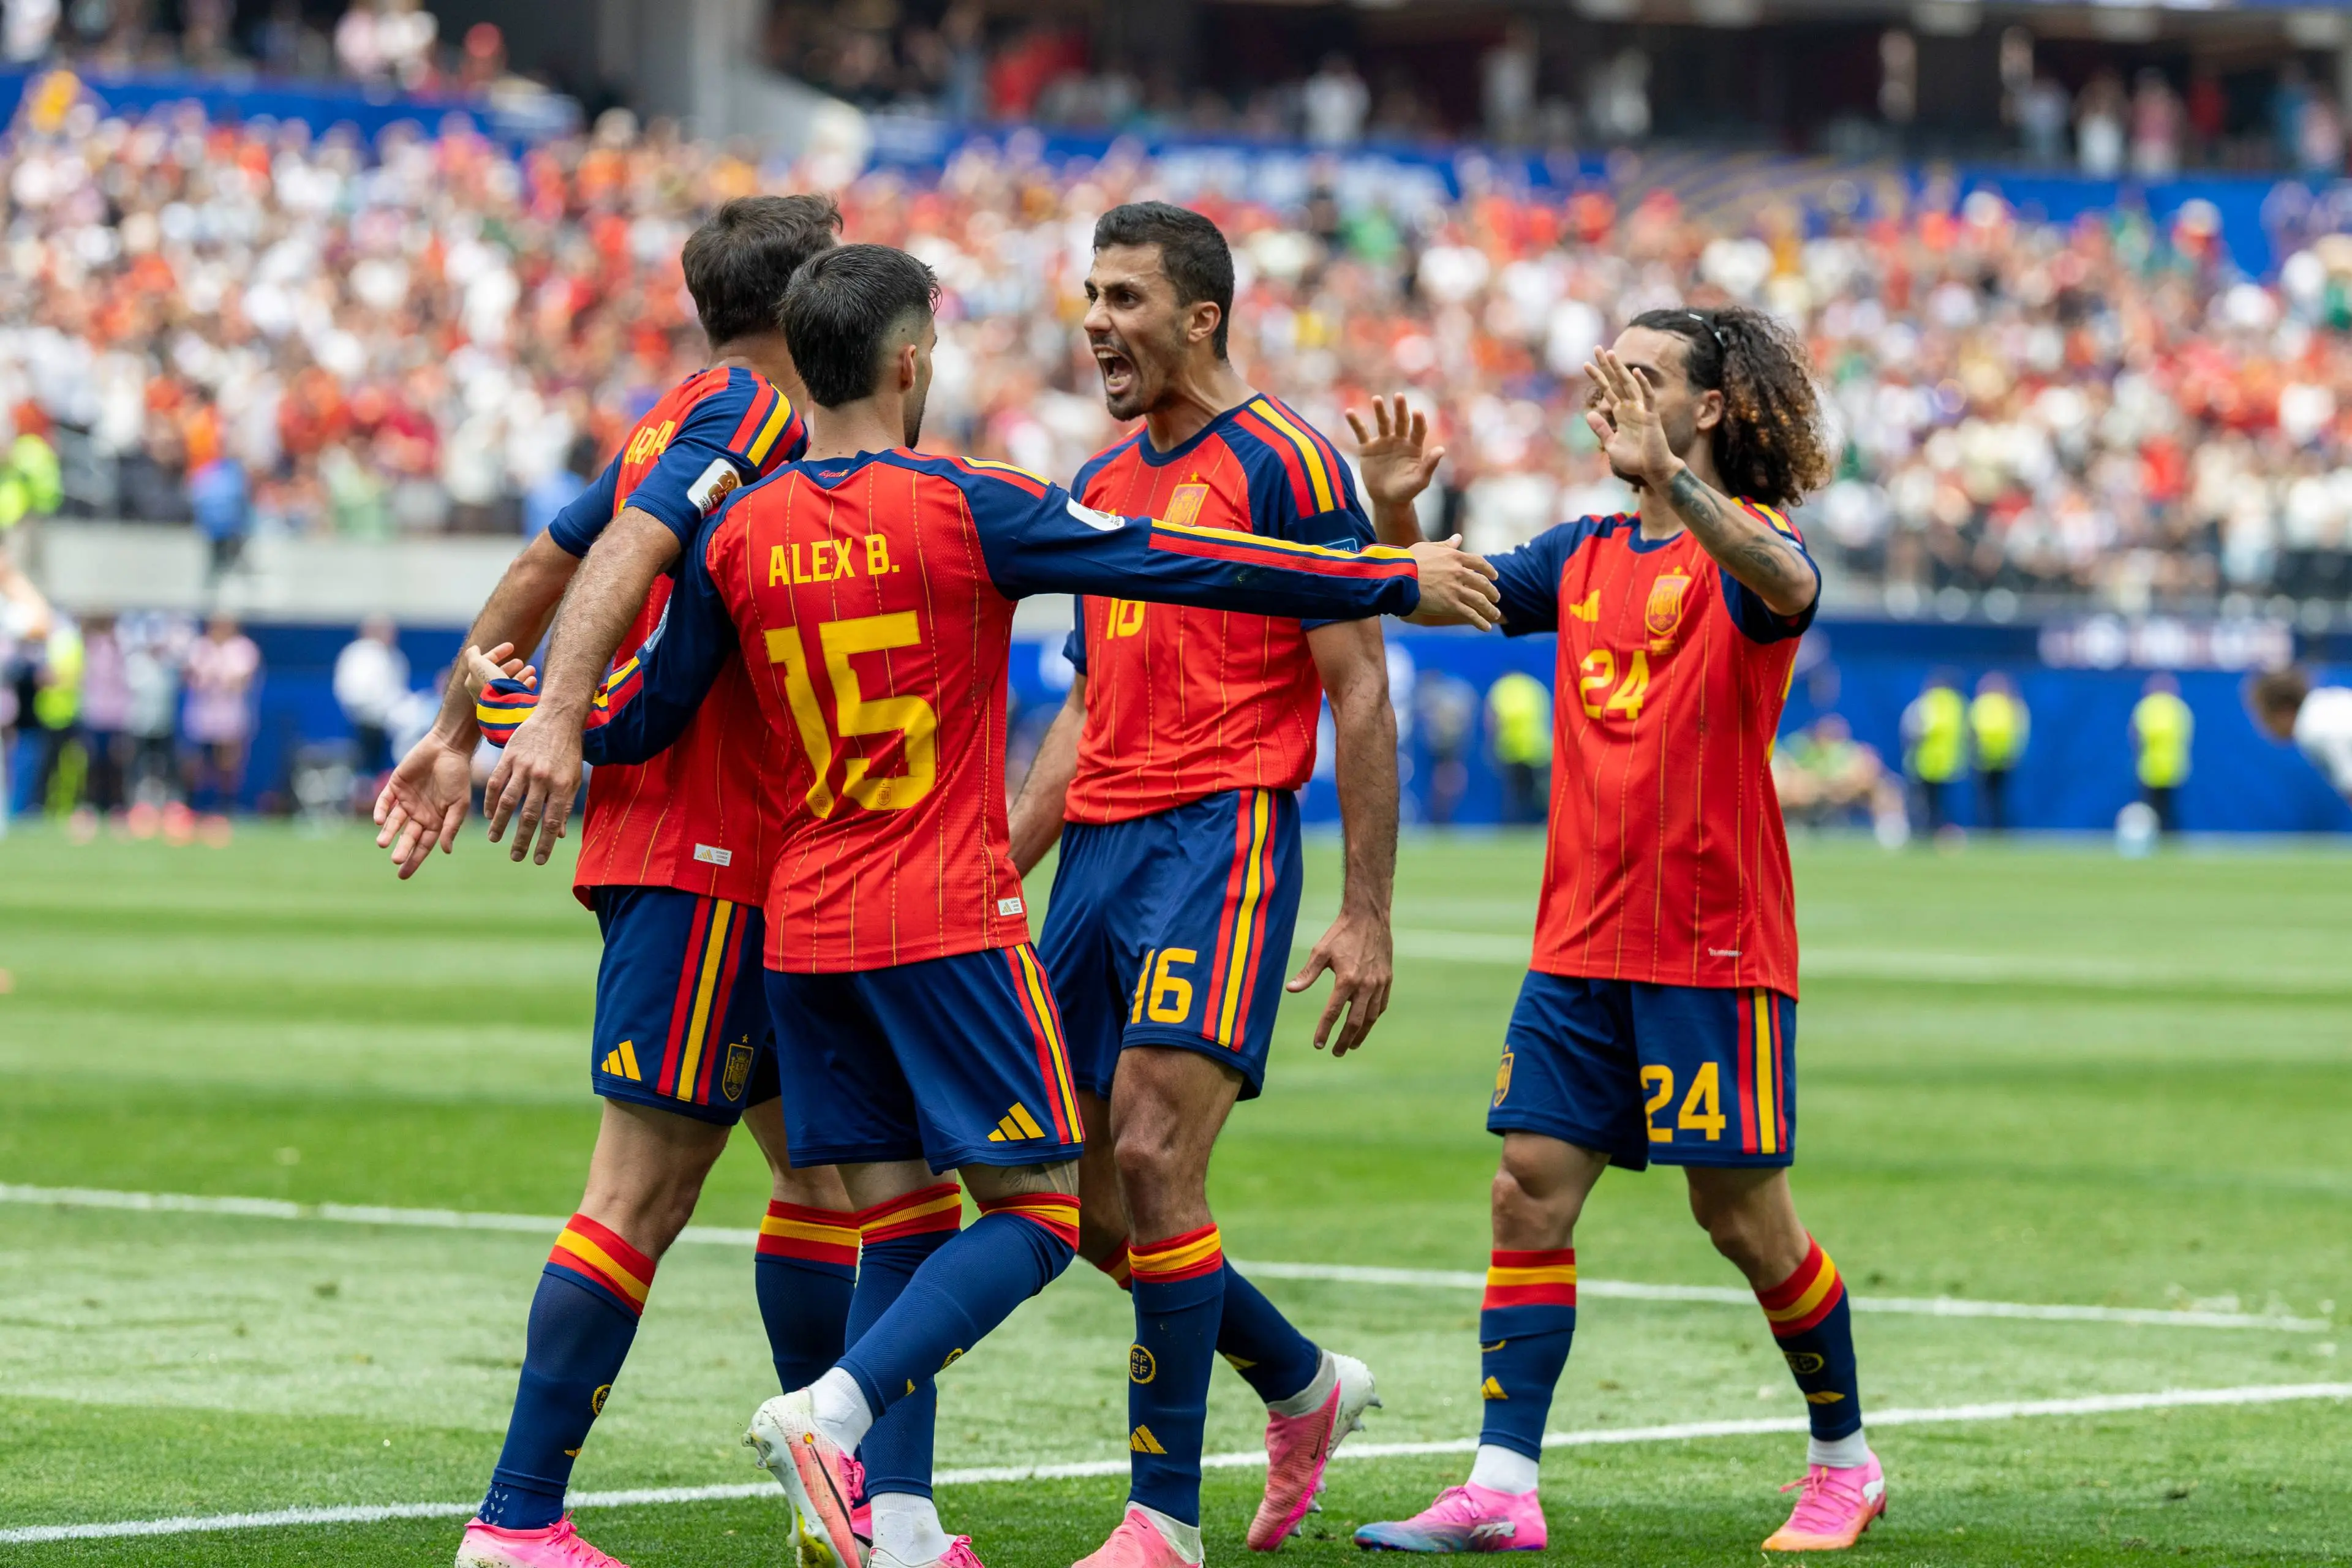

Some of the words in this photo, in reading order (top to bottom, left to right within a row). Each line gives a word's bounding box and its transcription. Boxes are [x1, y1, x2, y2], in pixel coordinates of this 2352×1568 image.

[769, 537, 856, 587] ALEX
[864, 533, 900, 575] B.
[764, 610, 937, 818] 15
[1580, 649, 1649, 720] 24
[1131, 947, 1197, 1024] 16
[1640, 1061, 1727, 1144] 24
